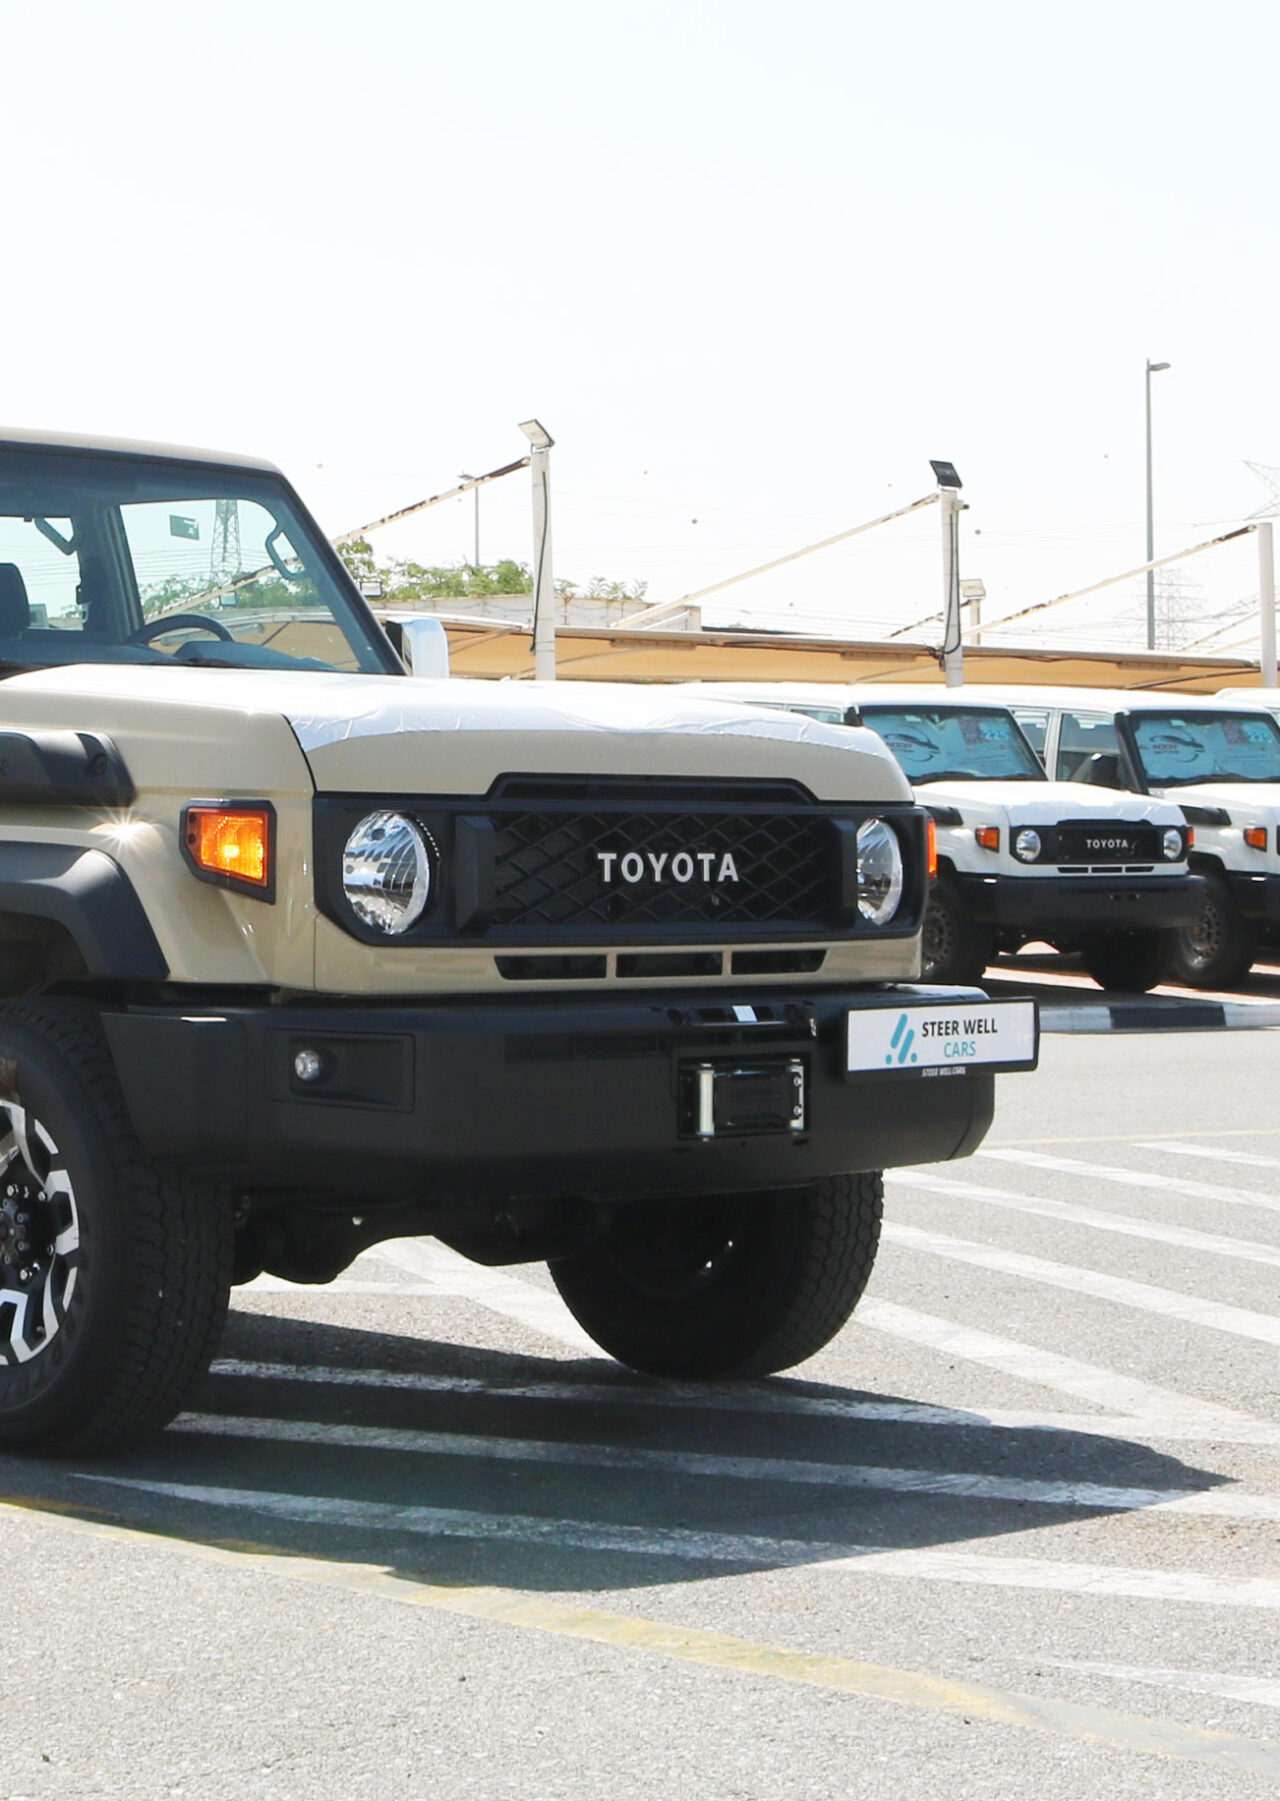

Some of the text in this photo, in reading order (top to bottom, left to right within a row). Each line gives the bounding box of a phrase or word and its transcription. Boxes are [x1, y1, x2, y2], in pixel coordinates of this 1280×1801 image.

[1086, 839, 1129, 849] TOYOTA
[597, 852, 740, 883] TOYOTA
[921, 1018, 999, 1038] STEER WELL
[943, 1041, 977, 1058] CARS
